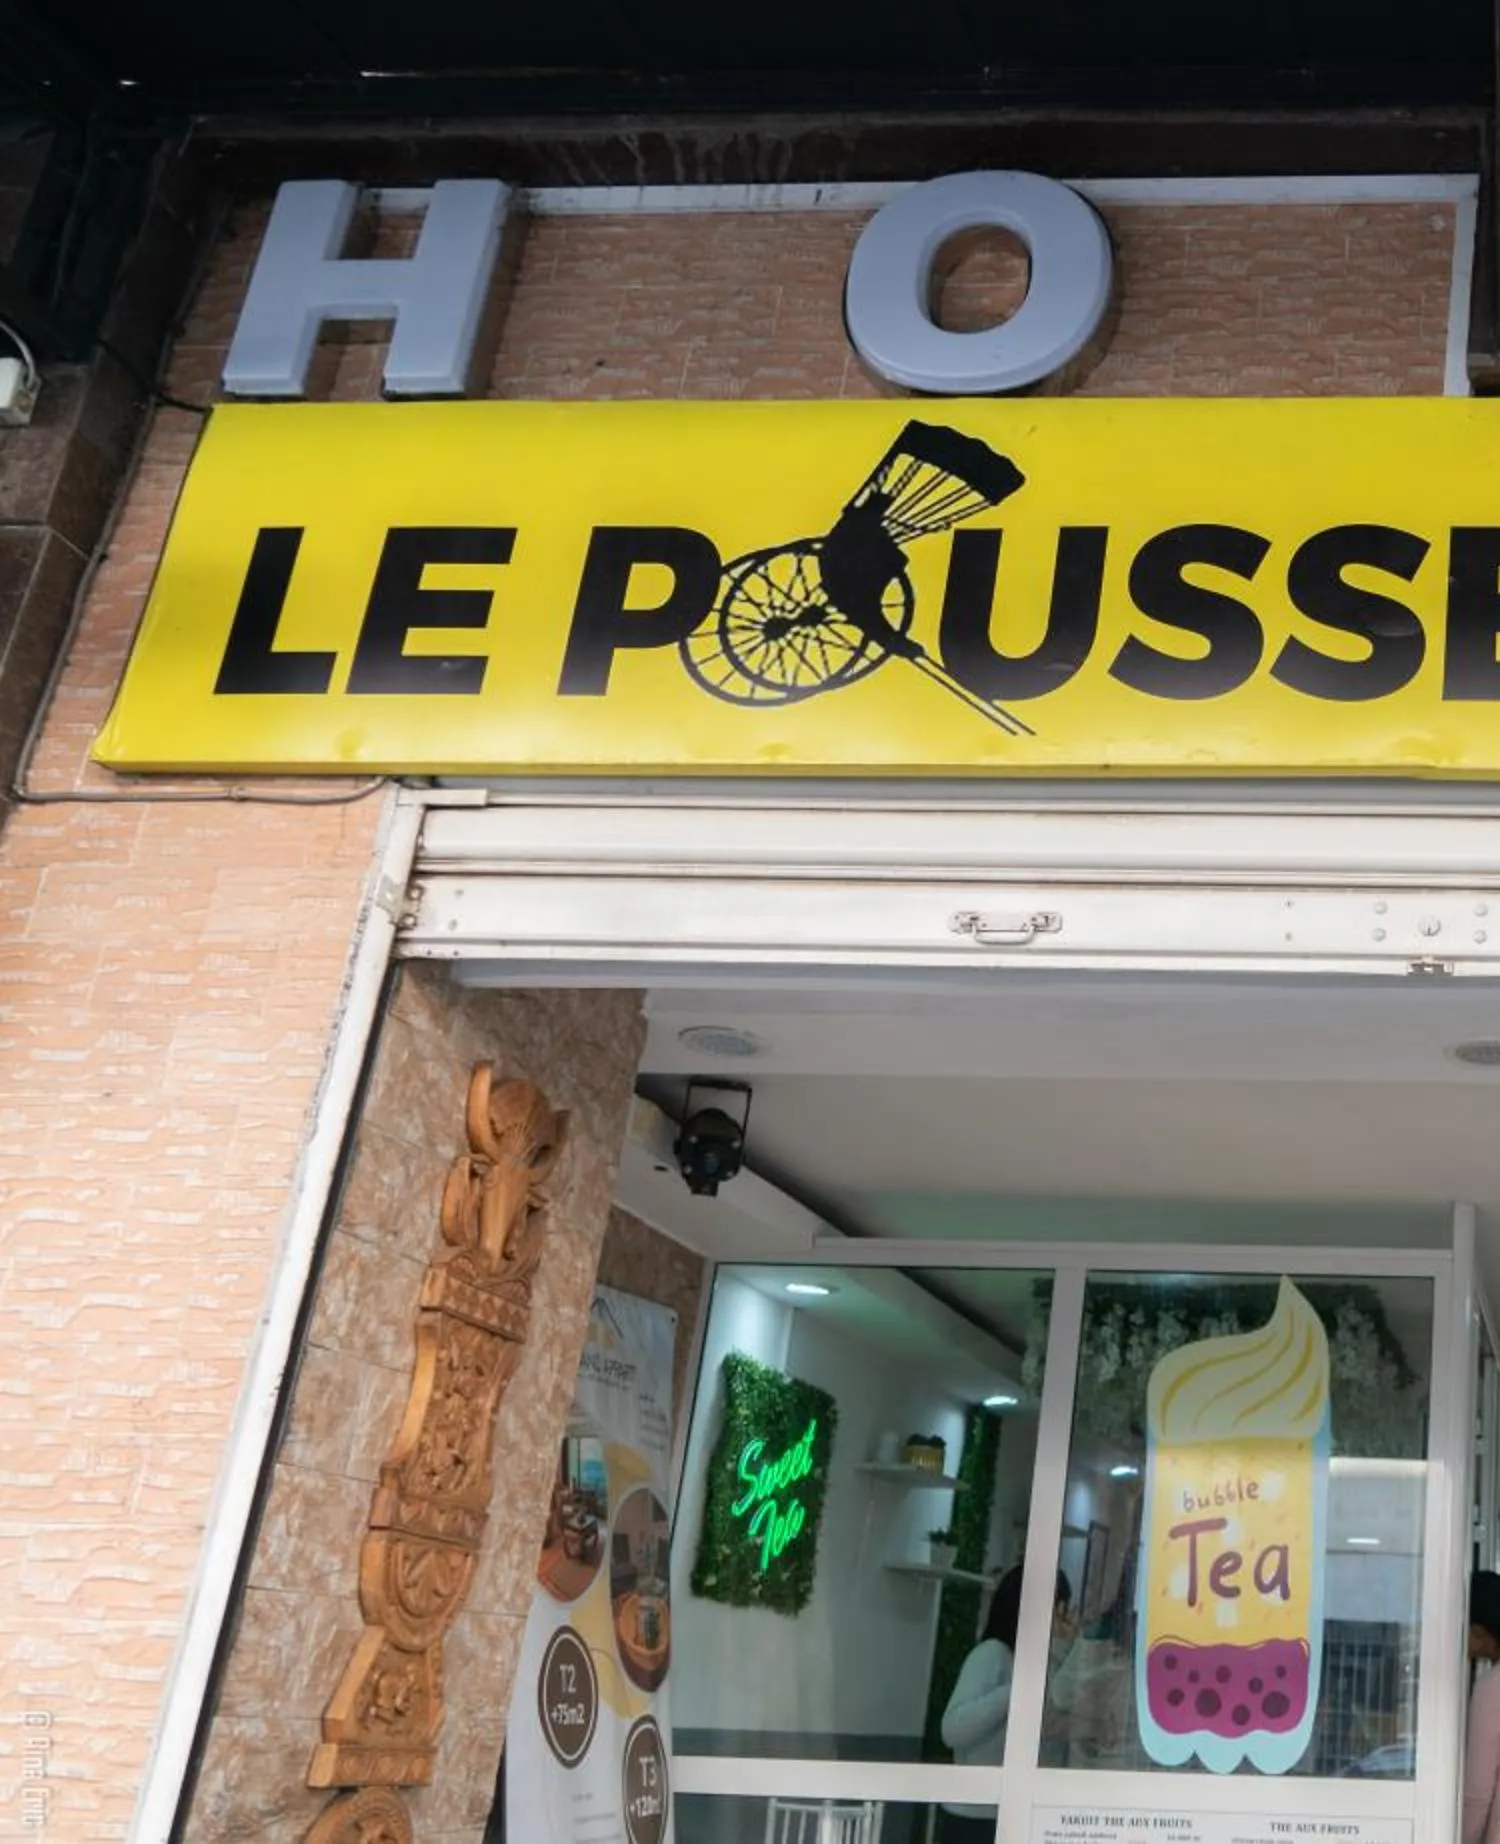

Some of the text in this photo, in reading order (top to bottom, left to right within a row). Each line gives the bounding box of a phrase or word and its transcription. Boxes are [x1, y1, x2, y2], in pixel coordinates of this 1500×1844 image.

[212, 526, 518, 696] LE
[731, 1419, 817, 1517] Sweet
[1183, 1477, 1260, 1512] bubble
[748, 1499, 805, 1570] Tea
[1168, 1517, 1291, 1607] Tea
[559, 1663, 577, 1693] T2
[639, 1756, 657, 1786] T3
